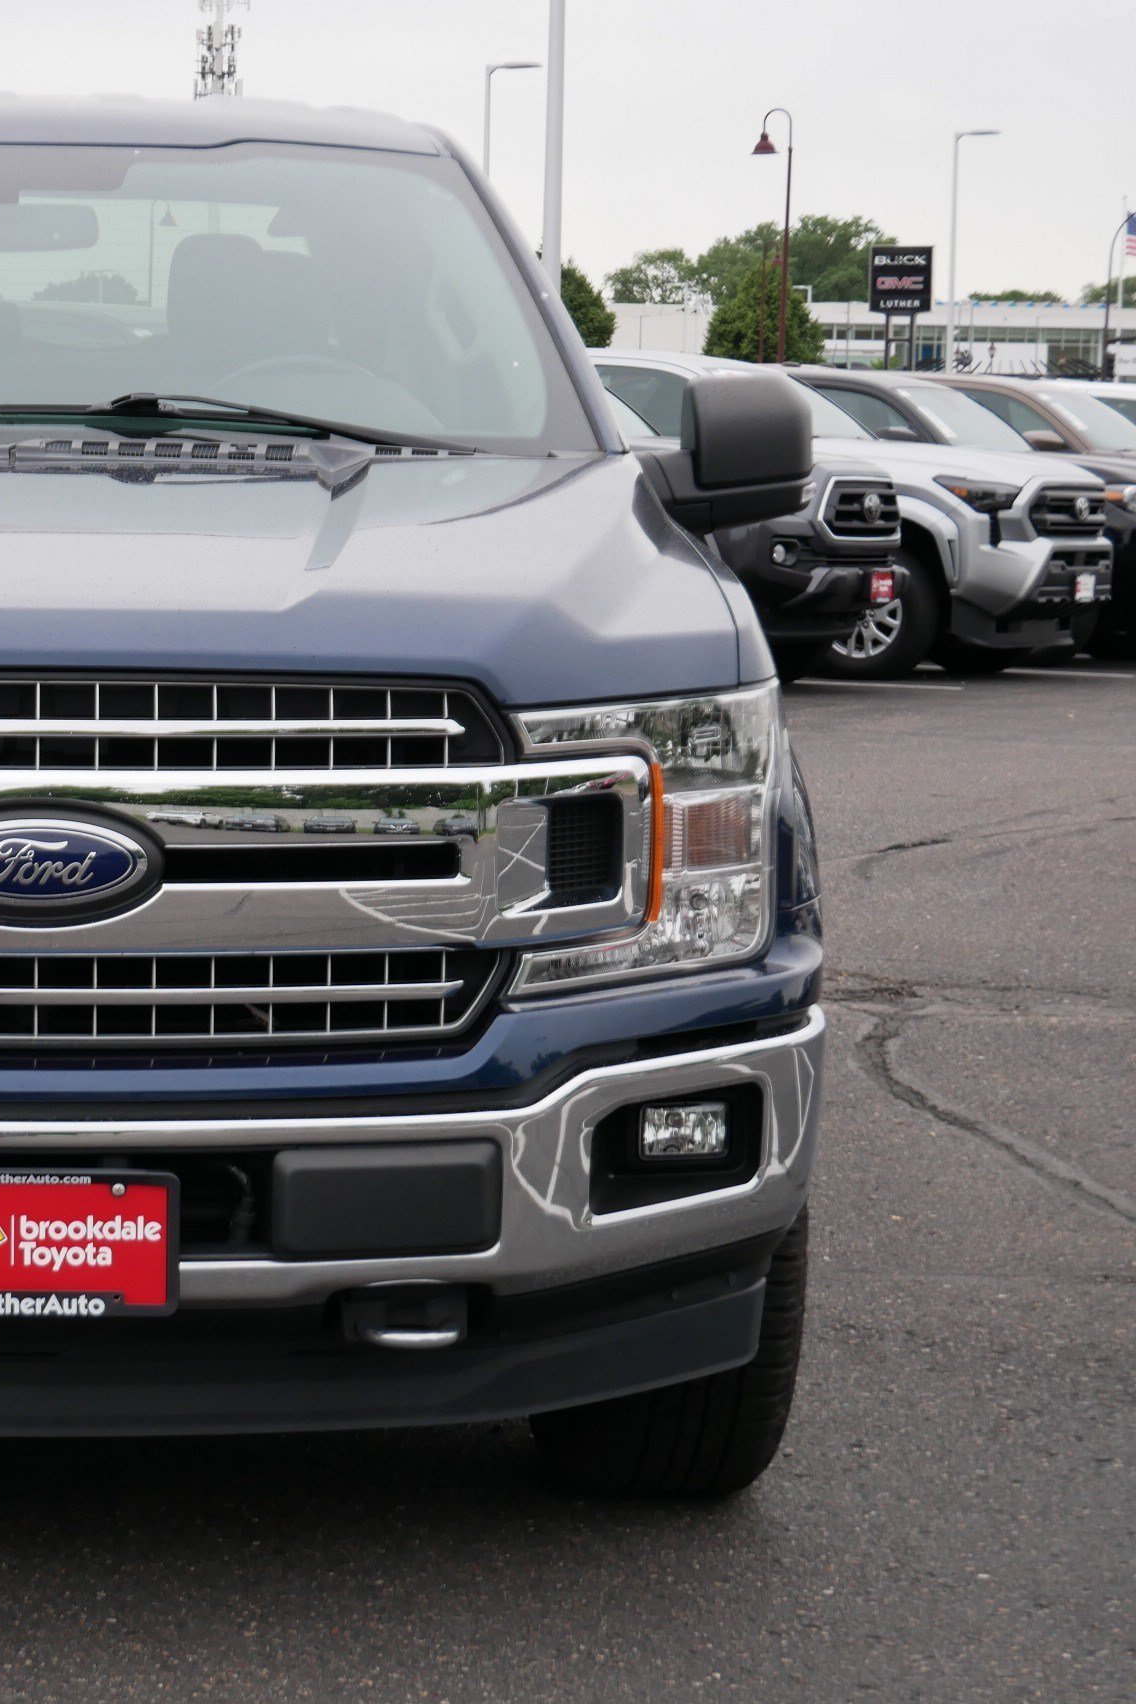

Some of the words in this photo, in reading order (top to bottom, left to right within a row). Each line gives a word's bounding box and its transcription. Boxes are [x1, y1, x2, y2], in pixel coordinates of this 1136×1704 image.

[874, 255, 927, 266] BUICK
[876, 276, 924, 290] GMC
[879, 299, 921, 309] LUTHER
[19, 1214, 162, 1241] brookdale
[18, 1241, 113, 1272] Toyota
